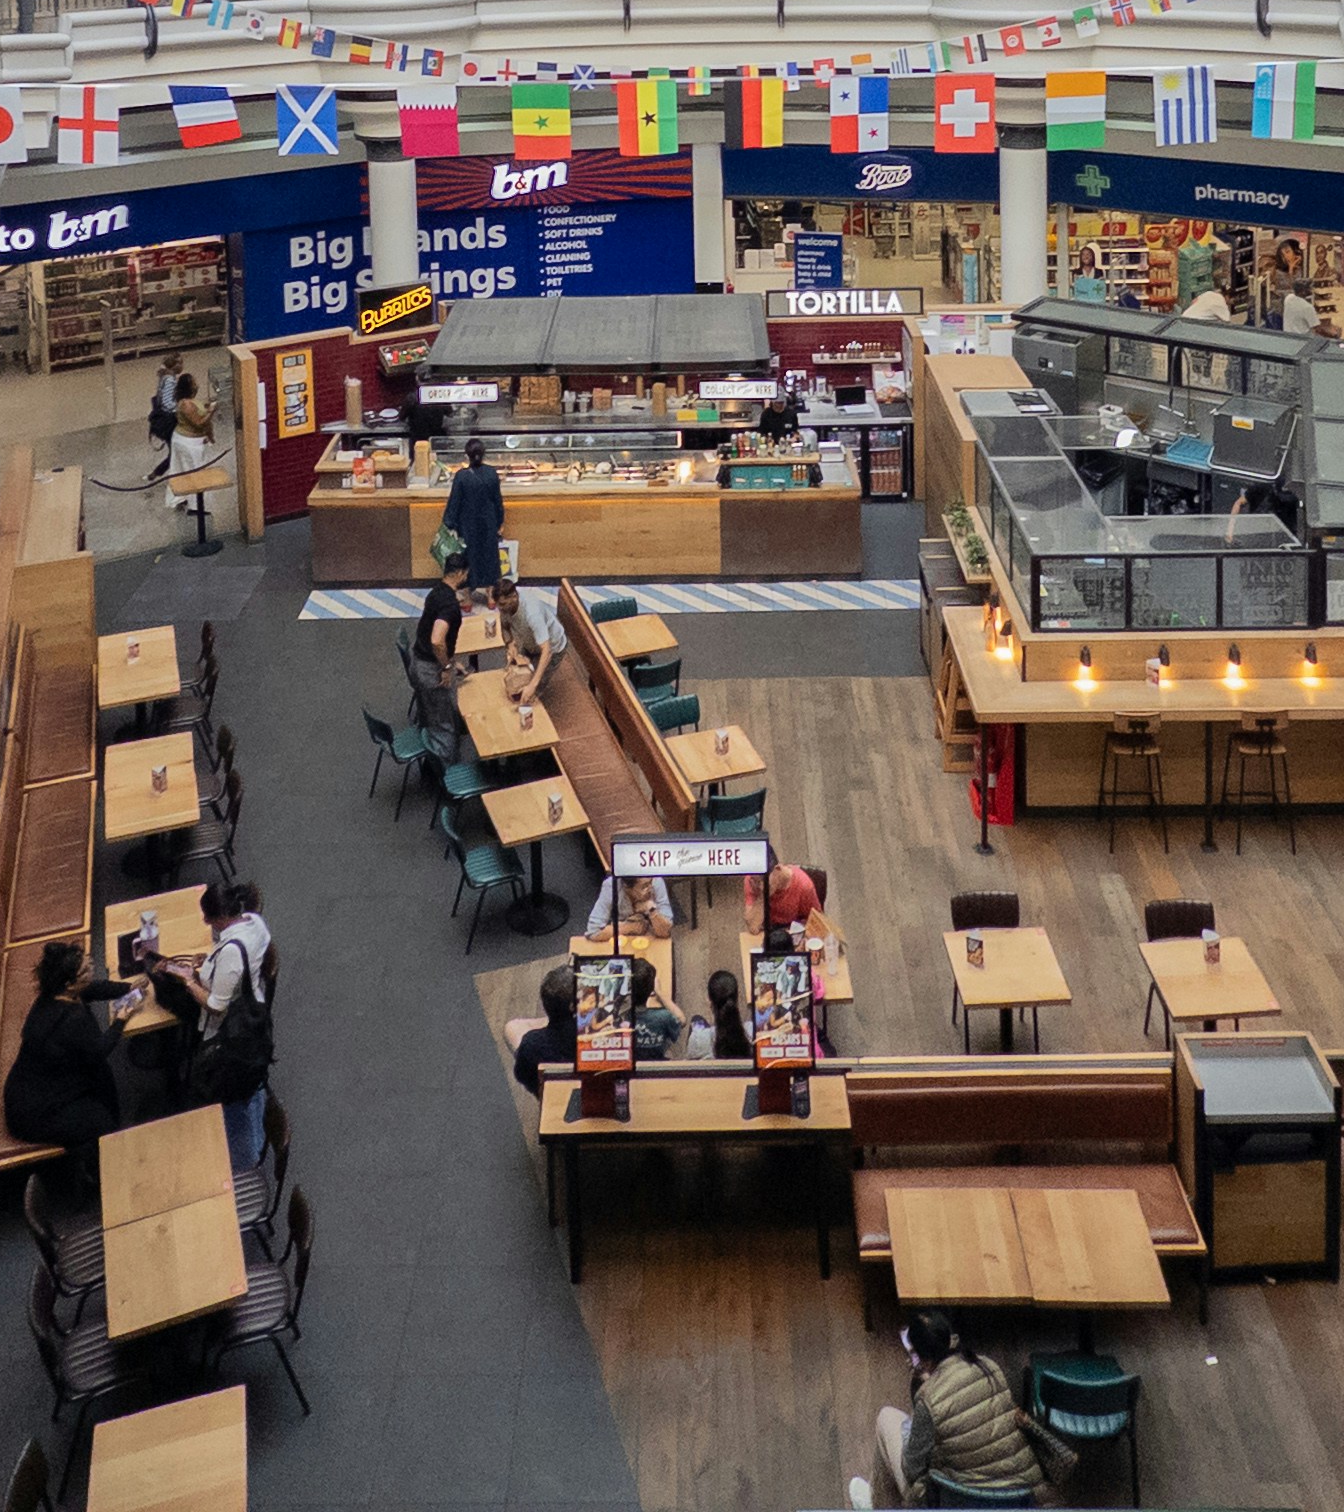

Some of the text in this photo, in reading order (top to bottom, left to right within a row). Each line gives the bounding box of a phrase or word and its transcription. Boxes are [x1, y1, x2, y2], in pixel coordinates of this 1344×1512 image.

[490, 161, 568, 200] b&m
[855, 163, 912, 191] Boots
[1195, 184, 1290, 209] pharmacy
[47, 204, 129, 250] b&m
[544, 214, 617, 226] CONFECTIONERY
[544, 226, 604, 239] SOFT DRINKS
[797, 237, 839, 247] welcome
[289, 231, 354, 270] Big
[544, 240, 588, 251] ALCOHOL
[545, 252, 591, 263] CLEANING
[545, 263, 594, 275] TOILETRIES
[547, 277, 563, 287] PET
[283, 276, 348, 313] Big
[785, 290, 903, 315] TORTILLA
[360, 286, 432, 334] BURRITOS
[704, 384, 735, 395] COLLECT
[640, 850, 671, 867] SKIP
[676, 848, 690, 858] the
[708, 848, 741, 866] HERE
